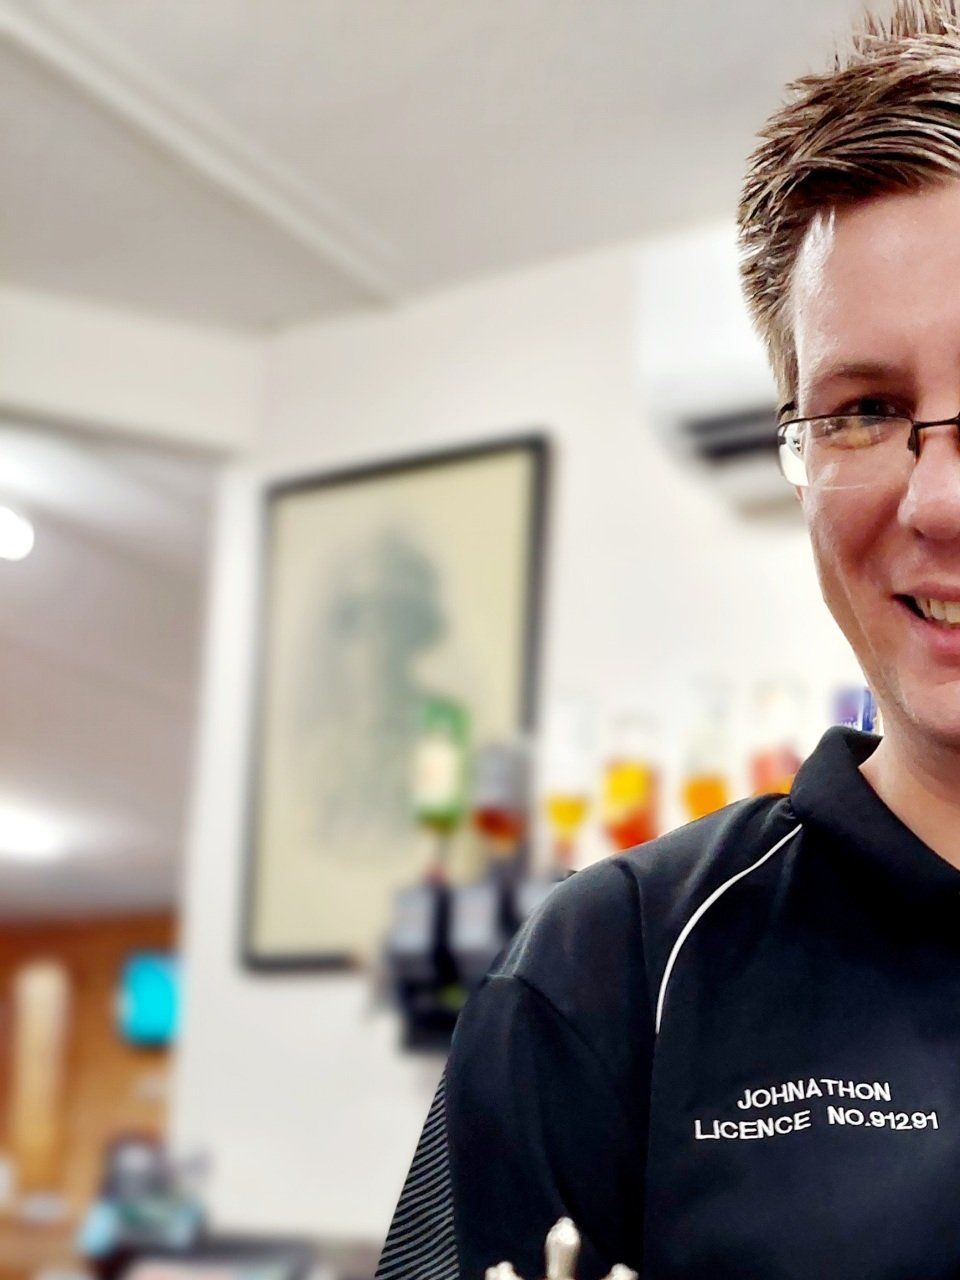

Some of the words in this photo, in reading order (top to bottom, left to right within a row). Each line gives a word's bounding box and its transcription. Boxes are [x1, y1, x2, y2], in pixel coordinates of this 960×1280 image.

[737, 1078, 891, 1110] JOHNATHON
[694, 1110, 812, 1140] LICENCE
[827, 1106, 938, 1131] NO.91291
